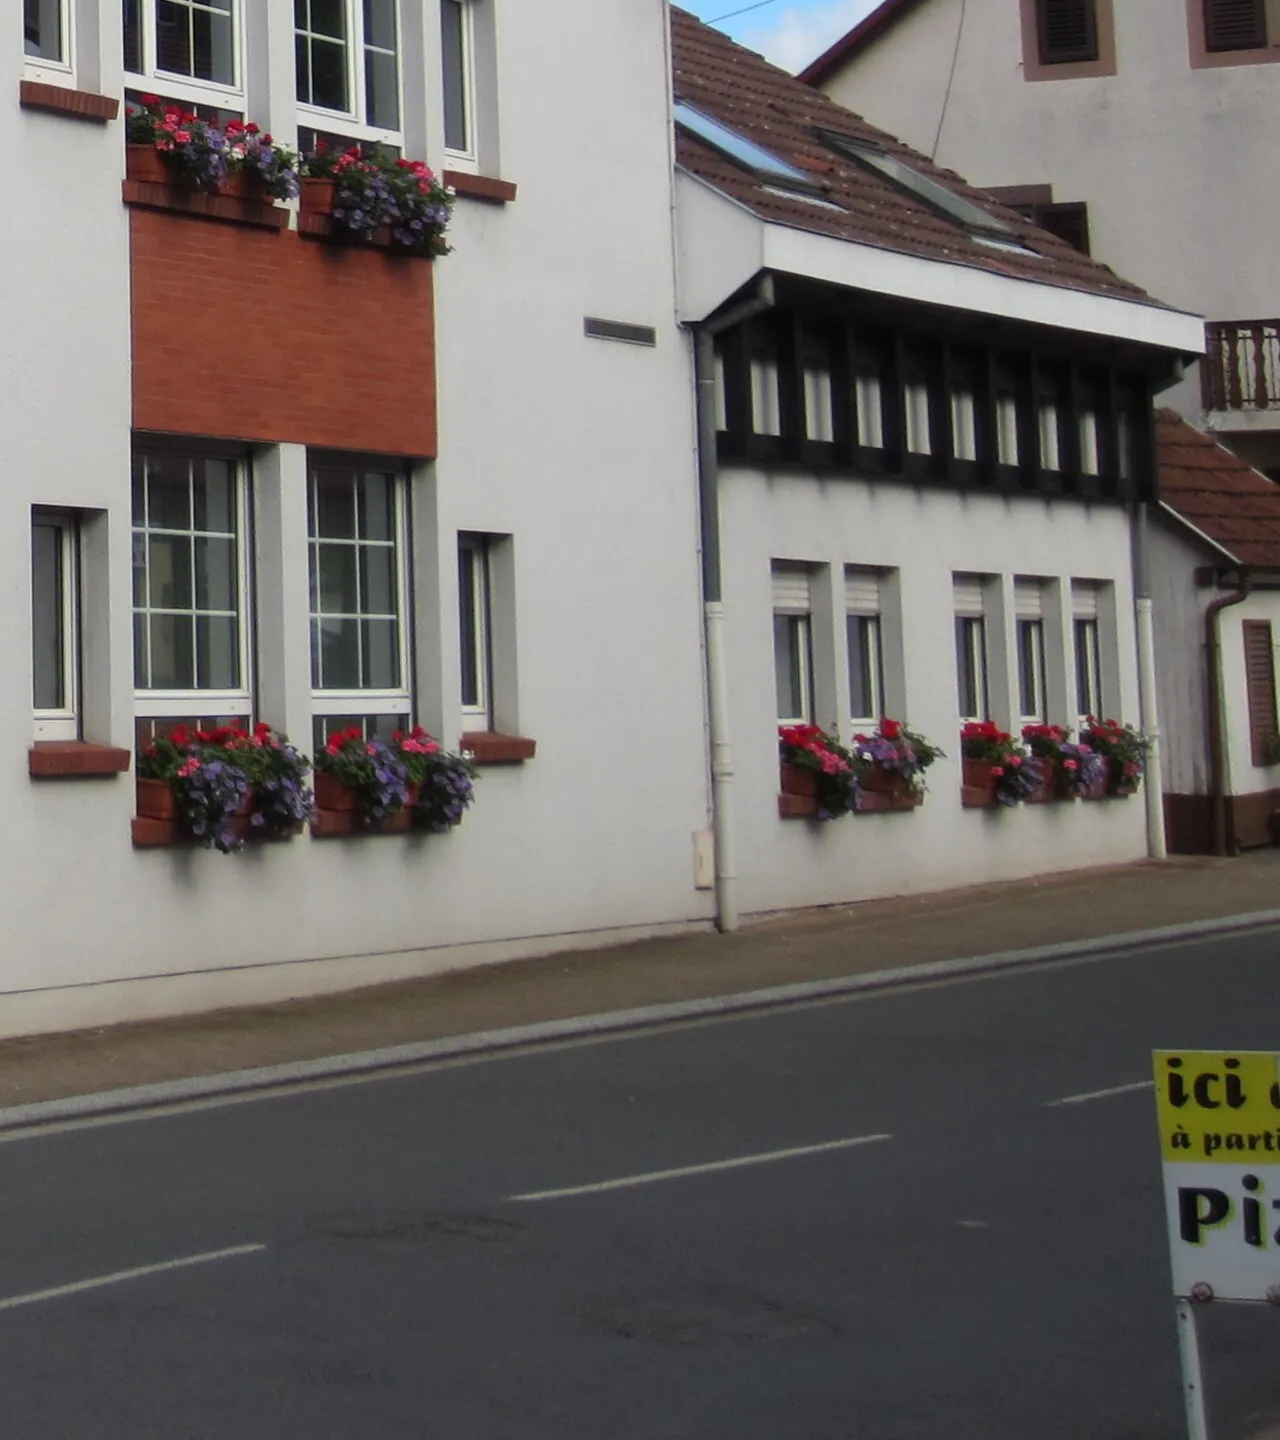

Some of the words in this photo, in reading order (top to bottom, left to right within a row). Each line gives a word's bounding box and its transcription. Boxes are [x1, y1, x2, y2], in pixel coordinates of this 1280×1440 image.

[1167, 1057, 1247, 1109] ici
[1171, 1123, 1191, 1149] à
[1177, 1173, 1280, 1247] Pi
